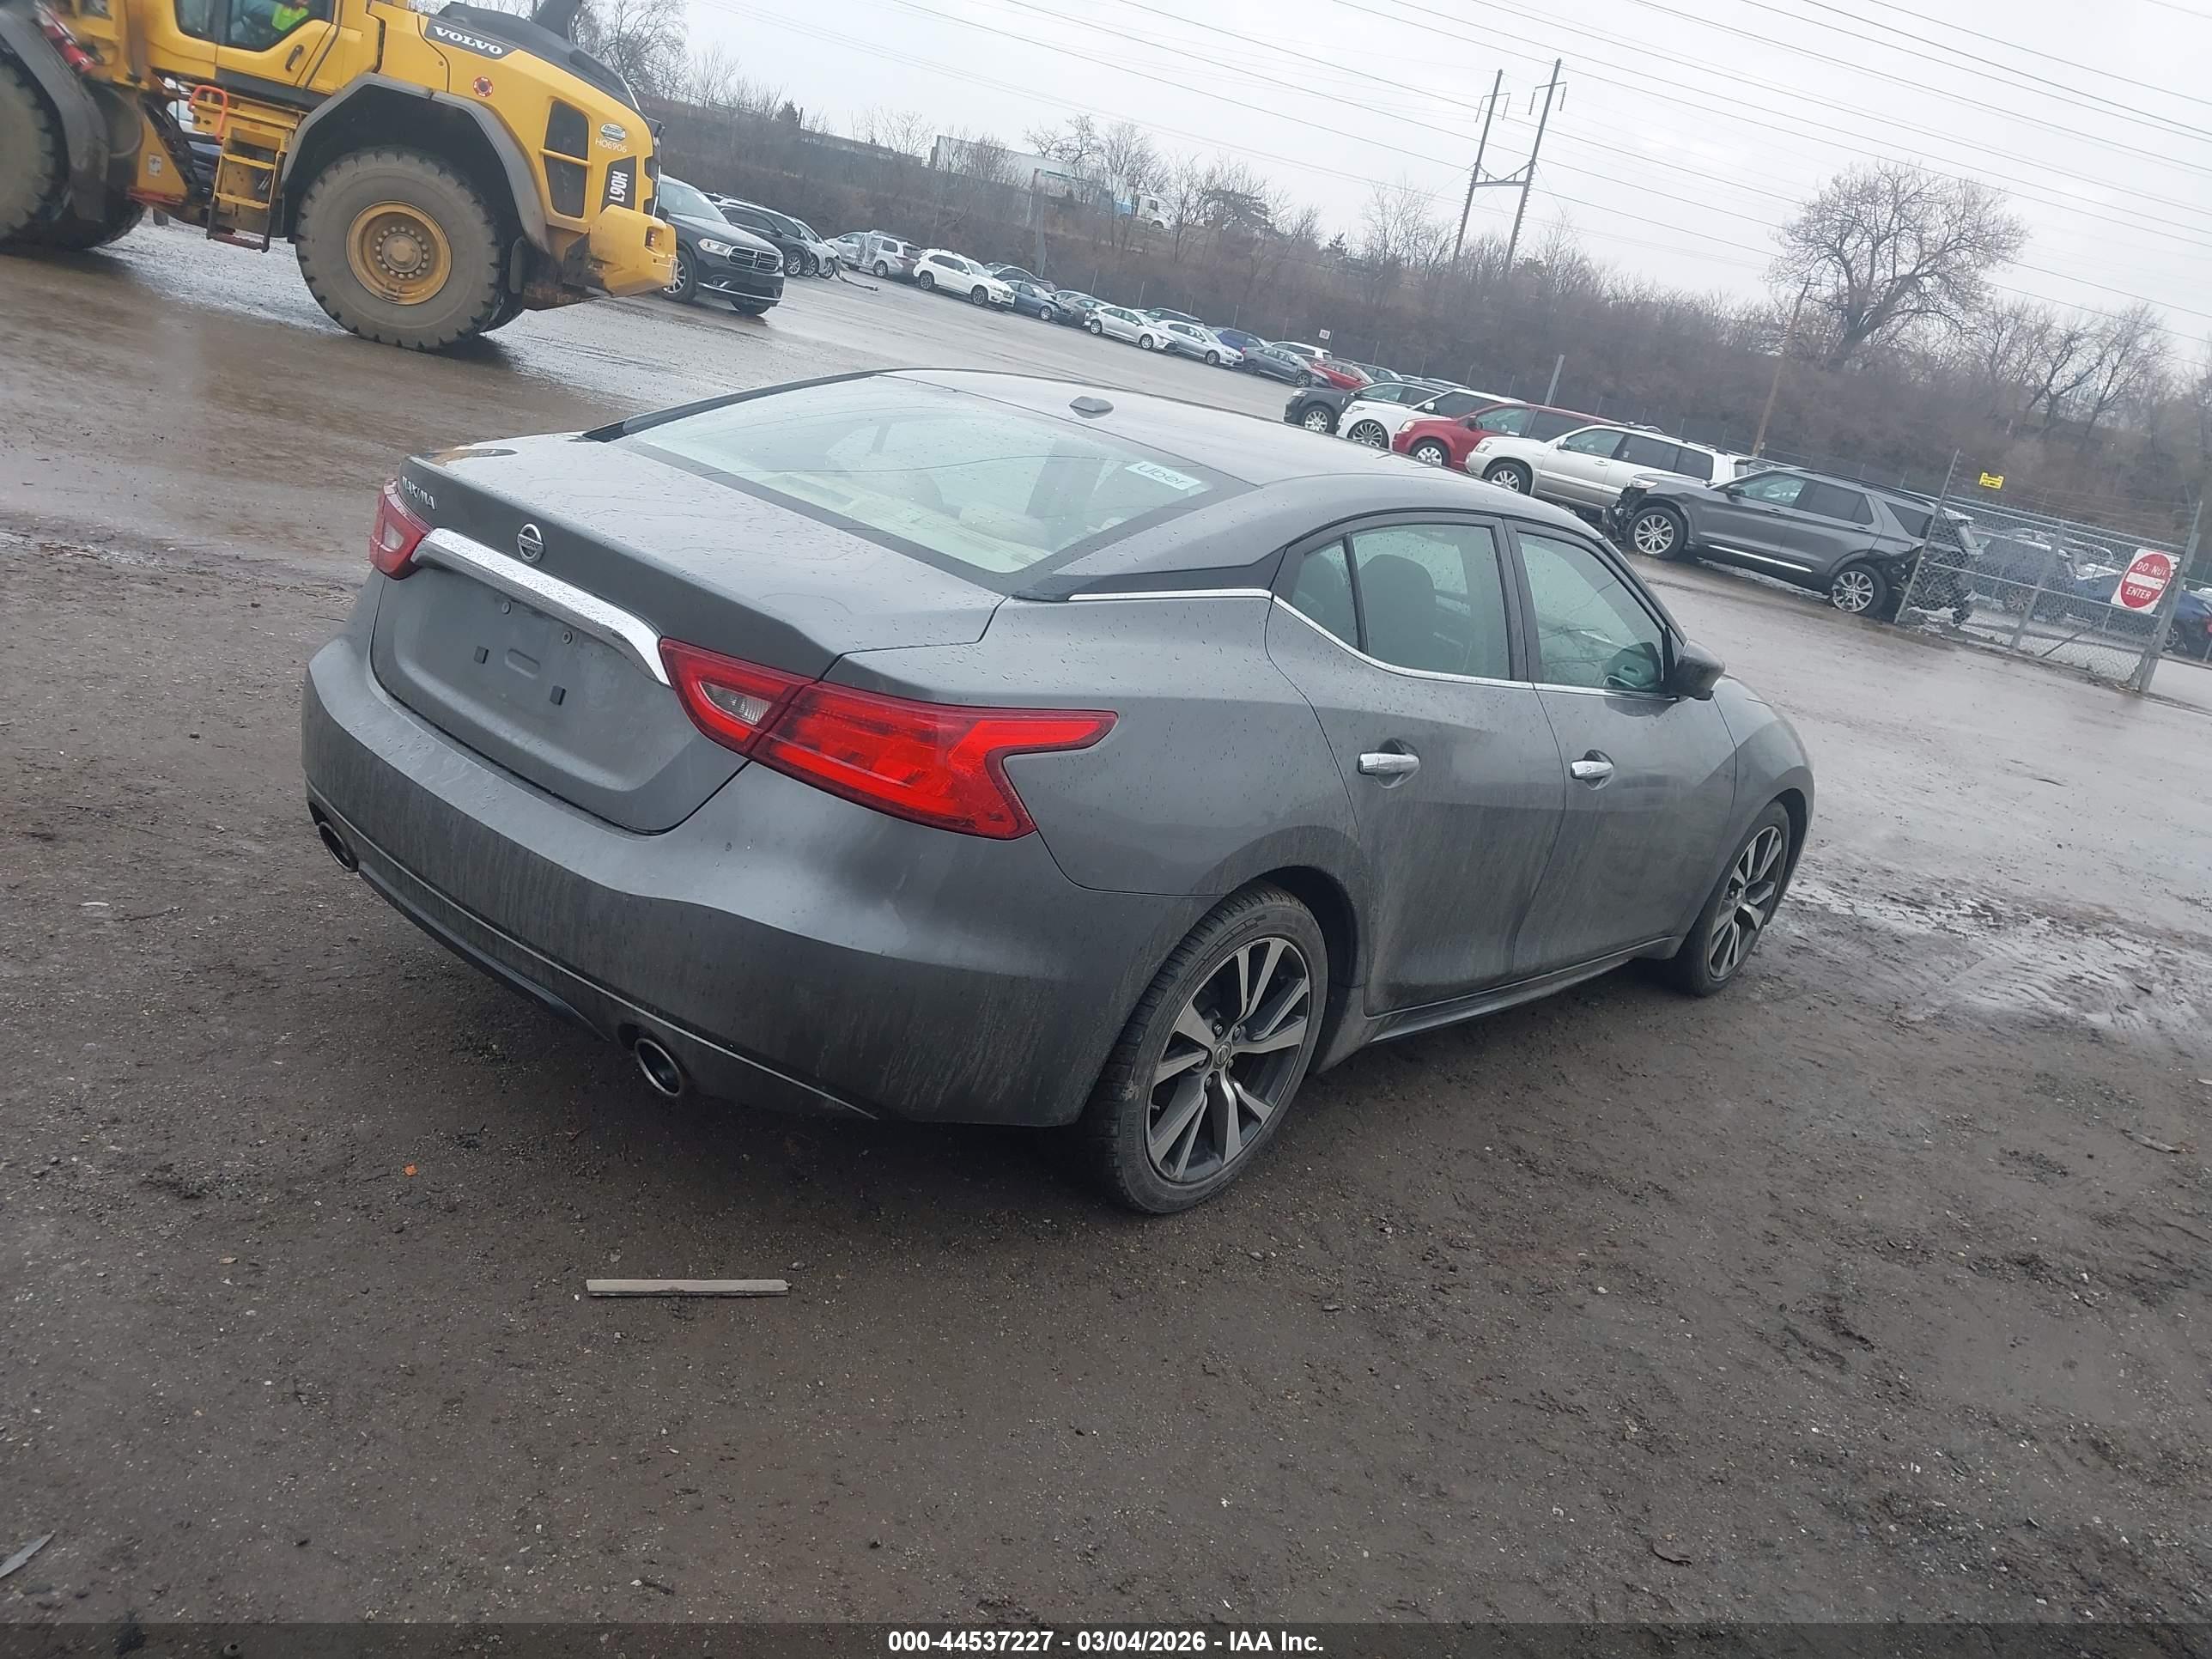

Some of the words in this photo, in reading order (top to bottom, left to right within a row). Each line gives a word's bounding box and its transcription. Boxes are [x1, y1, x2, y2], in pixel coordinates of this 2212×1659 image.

[433, 26, 503, 55] VOLVO
[608, 170, 629, 203] L90H
[1137, 465, 1189, 485] Uber
[2136, 561, 2149, 572] DO
[2125, 586, 2152, 599] ENTER
